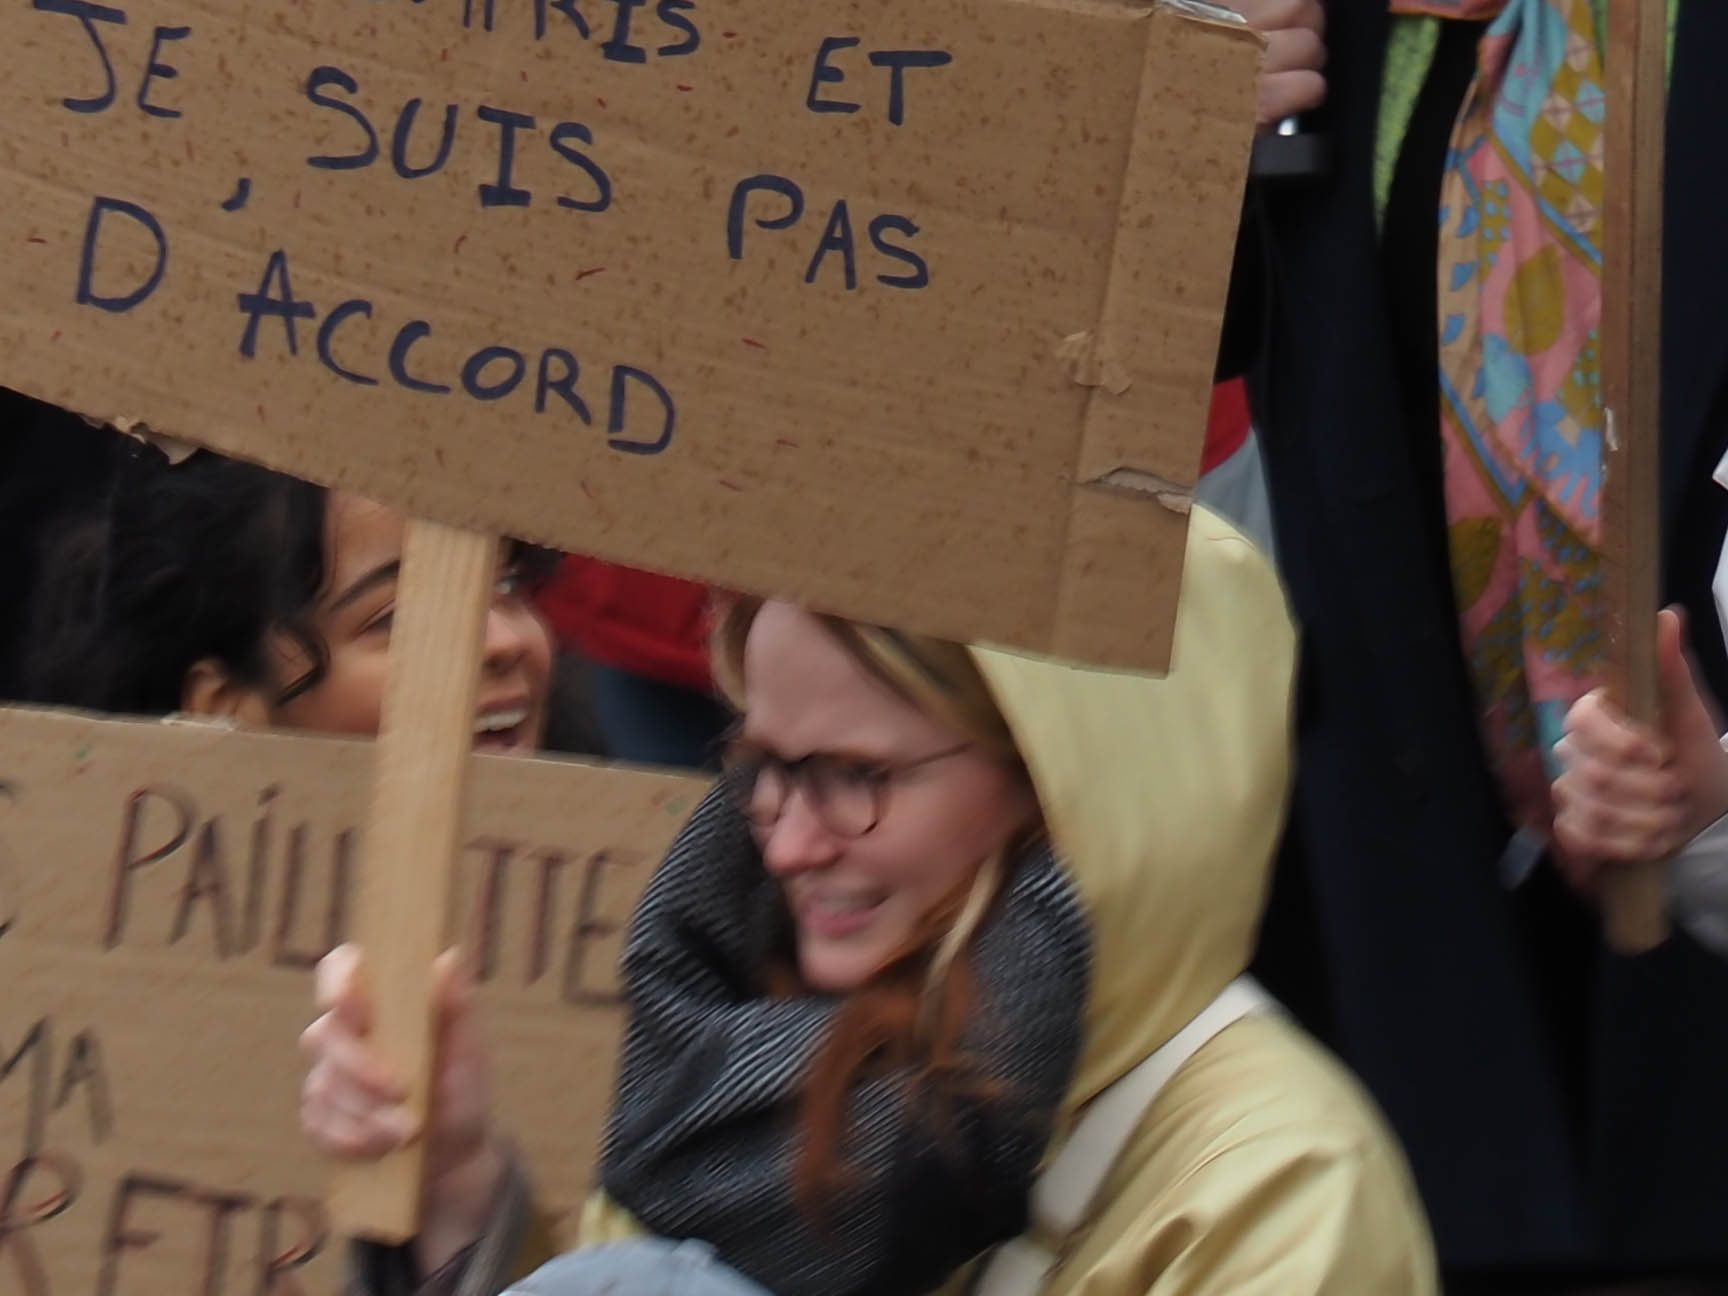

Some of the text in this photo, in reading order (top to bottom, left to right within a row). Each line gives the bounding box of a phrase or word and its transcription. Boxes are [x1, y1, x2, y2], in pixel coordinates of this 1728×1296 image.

[305, 65, 613, 214] SUIS
[726, 175, 932, 291] PAS
[804, 37, 952, 127] ET
[74, 176, 676, 457] D'ACCORD
